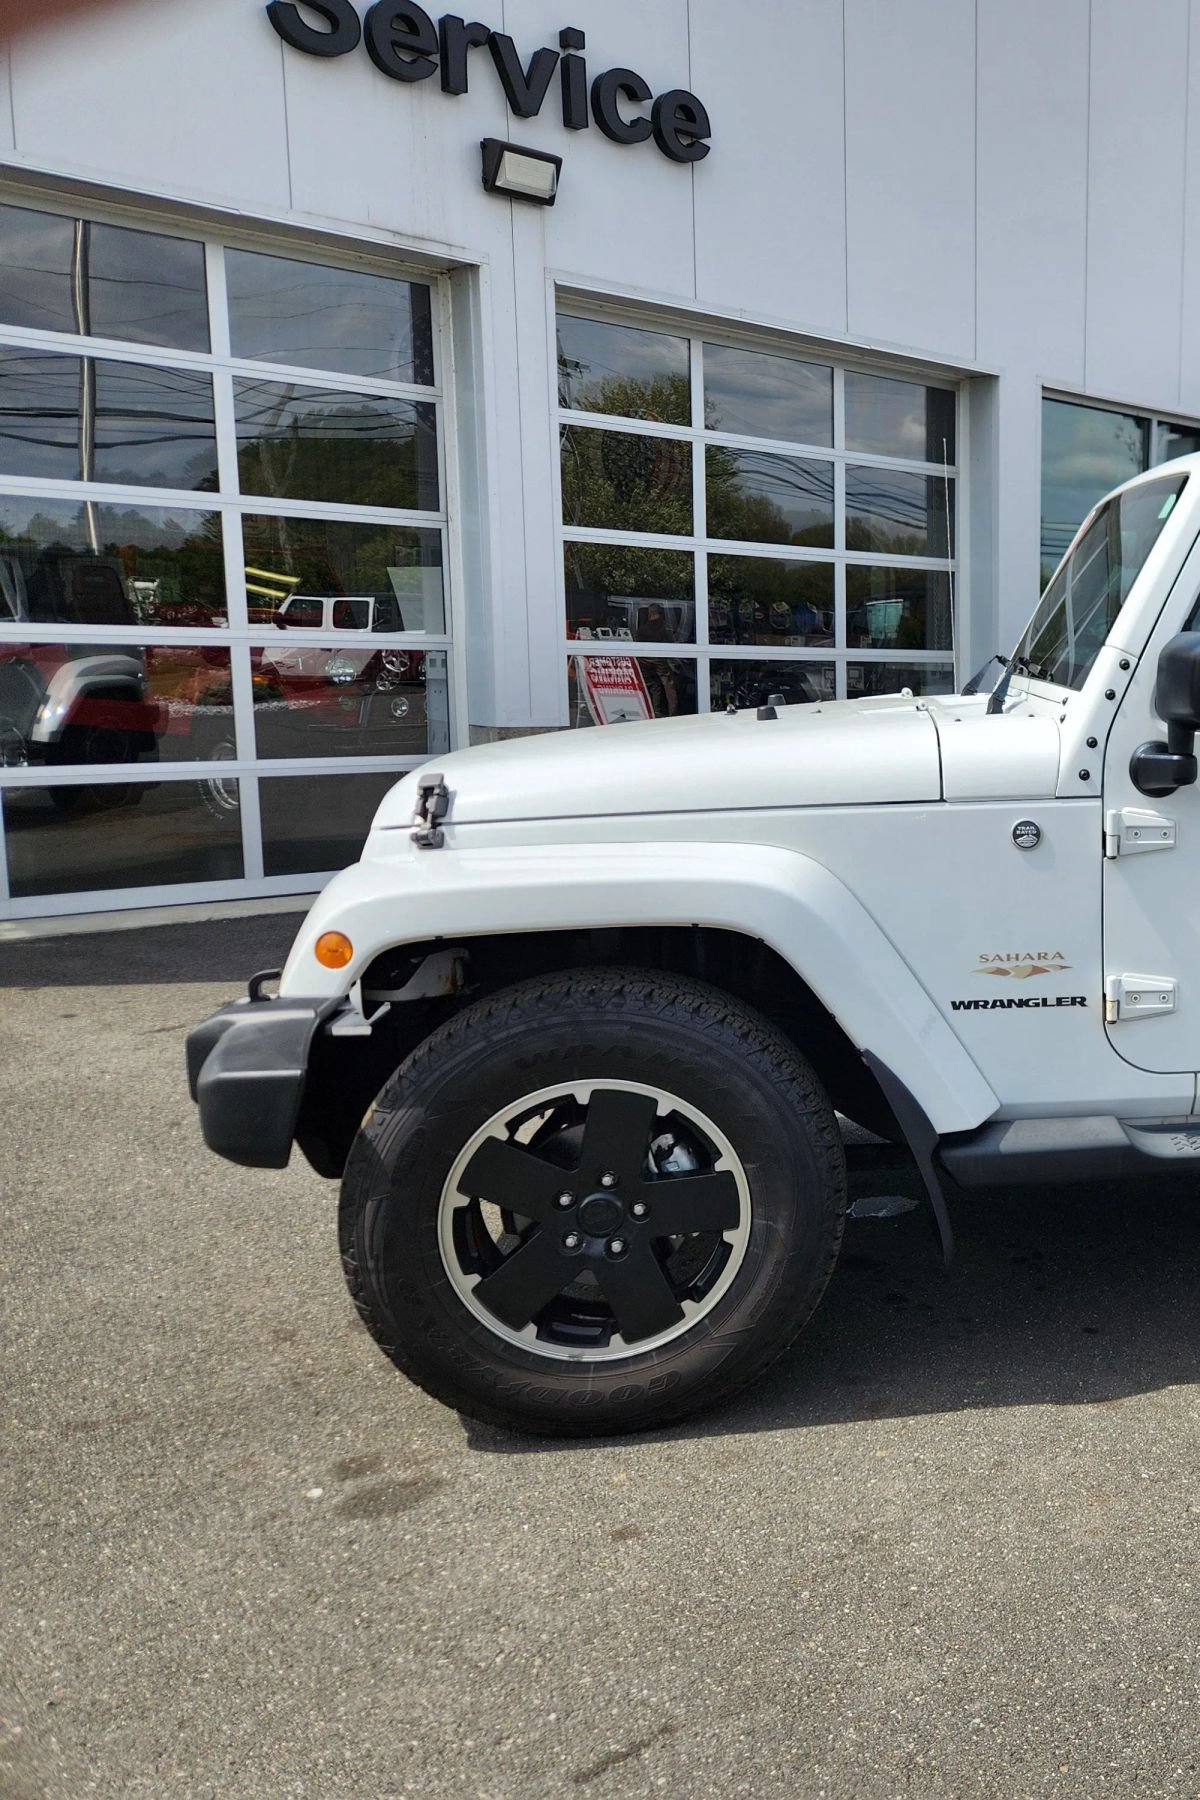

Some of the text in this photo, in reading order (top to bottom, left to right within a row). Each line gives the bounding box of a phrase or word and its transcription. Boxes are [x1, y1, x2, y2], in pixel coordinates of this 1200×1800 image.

[266, 0, 711, 163] Service
[979, 952, 1065, 963] SAHARA
[951, 996, 1088, 1011] WRANGLER
